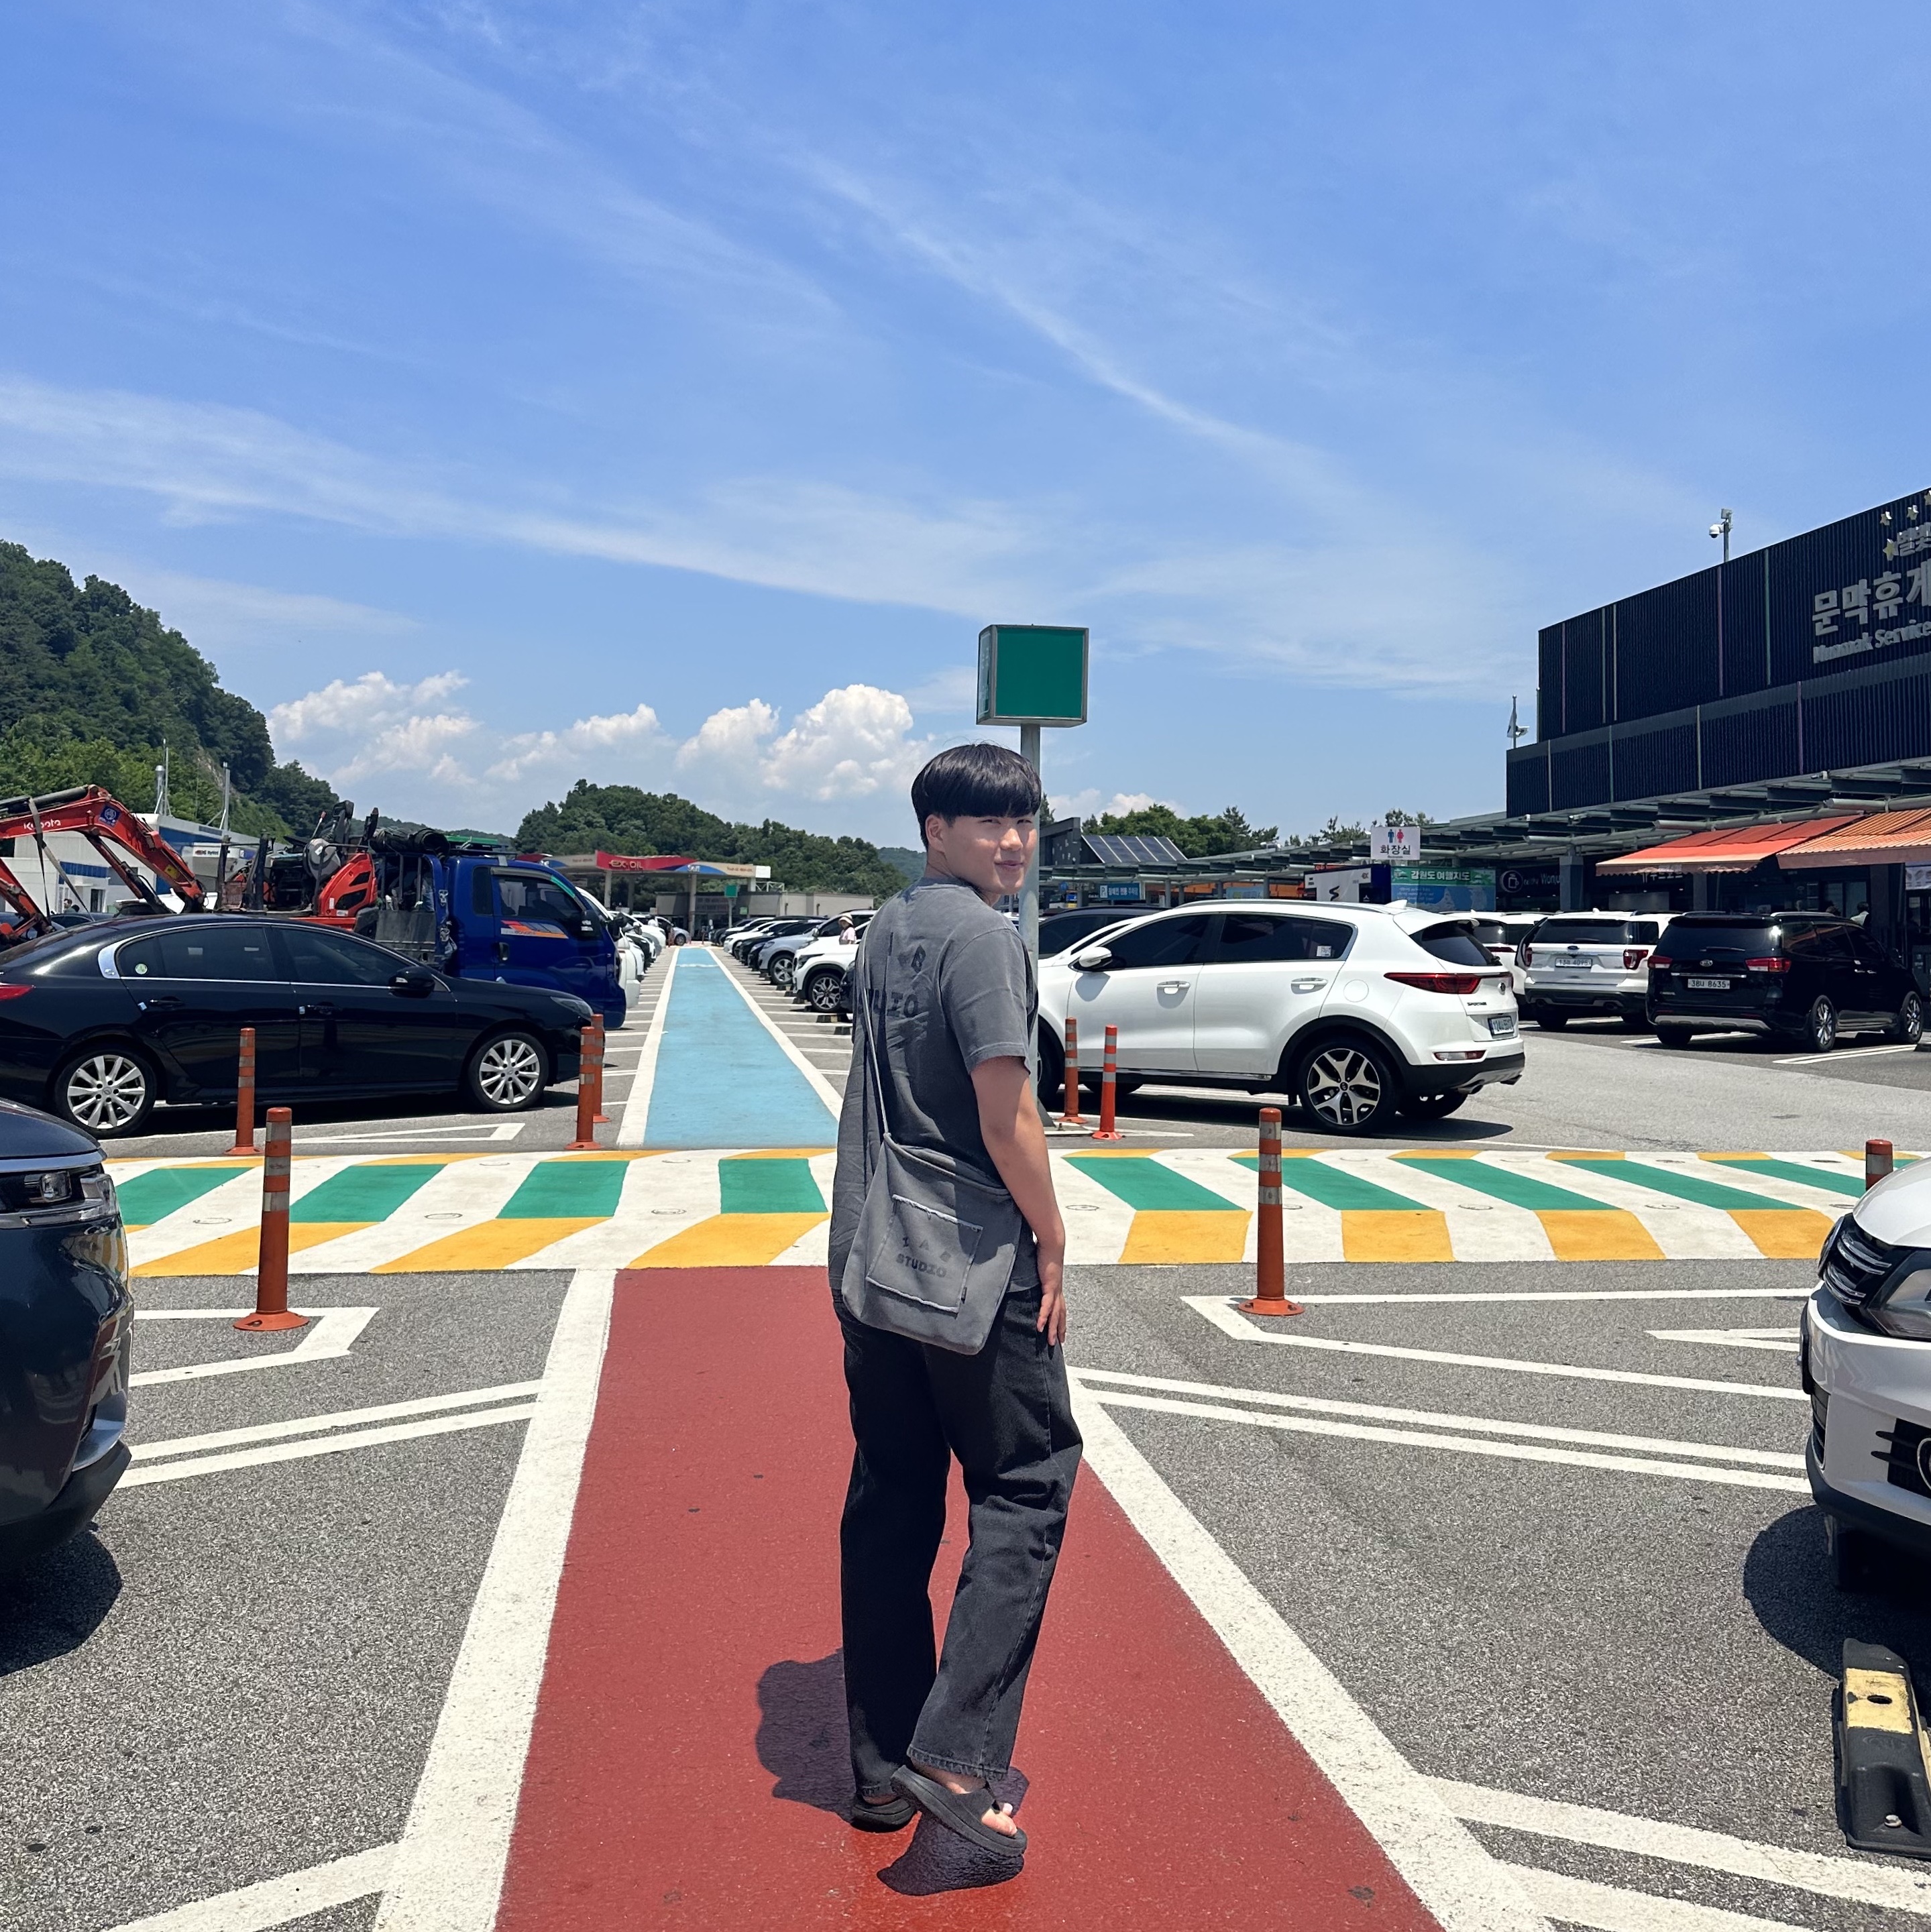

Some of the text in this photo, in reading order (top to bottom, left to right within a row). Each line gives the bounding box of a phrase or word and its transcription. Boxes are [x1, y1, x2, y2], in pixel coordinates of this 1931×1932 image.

[1380, 844, 1411, 855] 화장실
[1411, 870, 1470, 880] 강원도 여행지도
[1708, 980, 1726, 988] 8635
[895, 1253, 947, 1277] STUDIO
